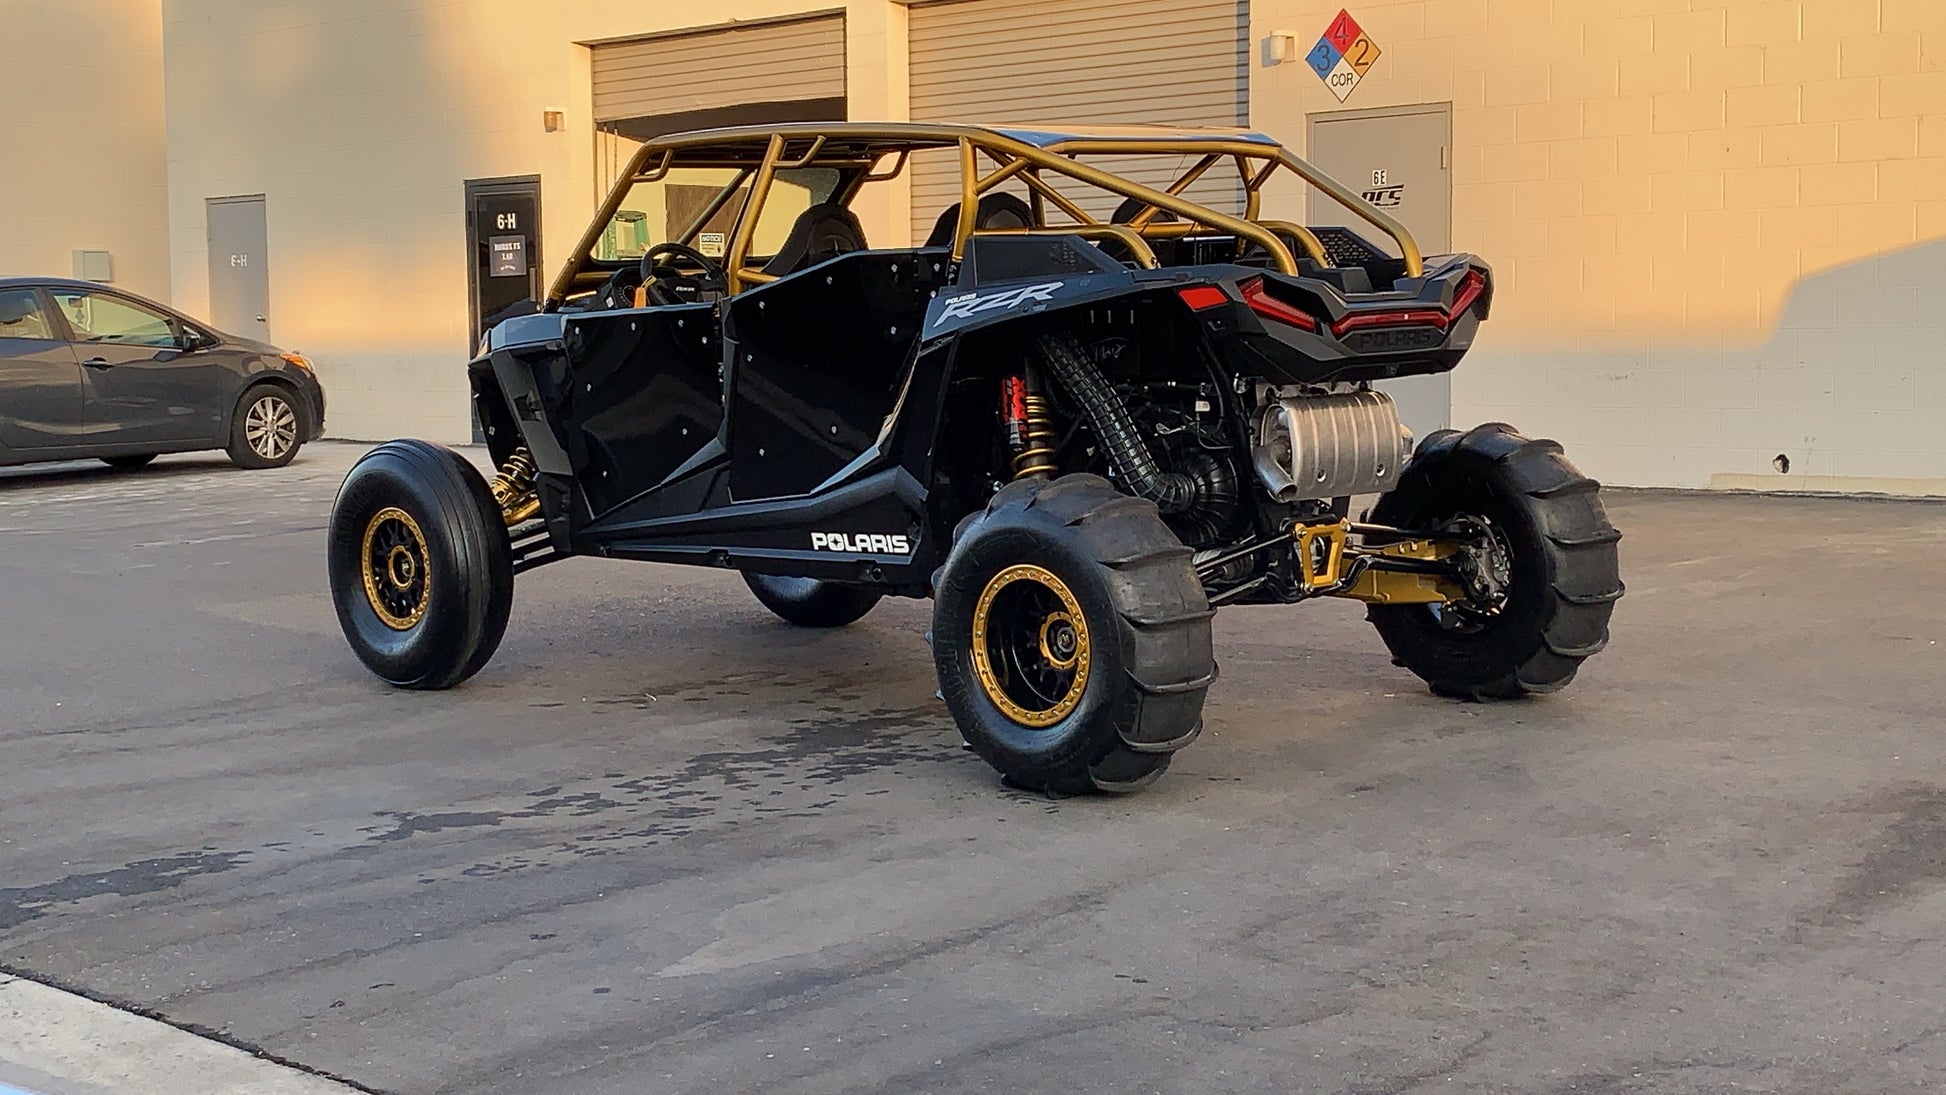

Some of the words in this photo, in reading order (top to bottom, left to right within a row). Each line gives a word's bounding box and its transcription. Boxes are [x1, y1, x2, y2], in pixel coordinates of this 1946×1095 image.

[1334, 16, 1349, 45] 4
[1316, 44, 1331, 72] 3
[1354, 38, 1370, 67] 2
[1331, 72, 1354, 87] COR
[1373, 170, 1386, 185] 6E
[497, 212, 517, 230] 6-H
[933, 281, 1065, 328] RZR
[810, 532, 910, 553] POLARIS
